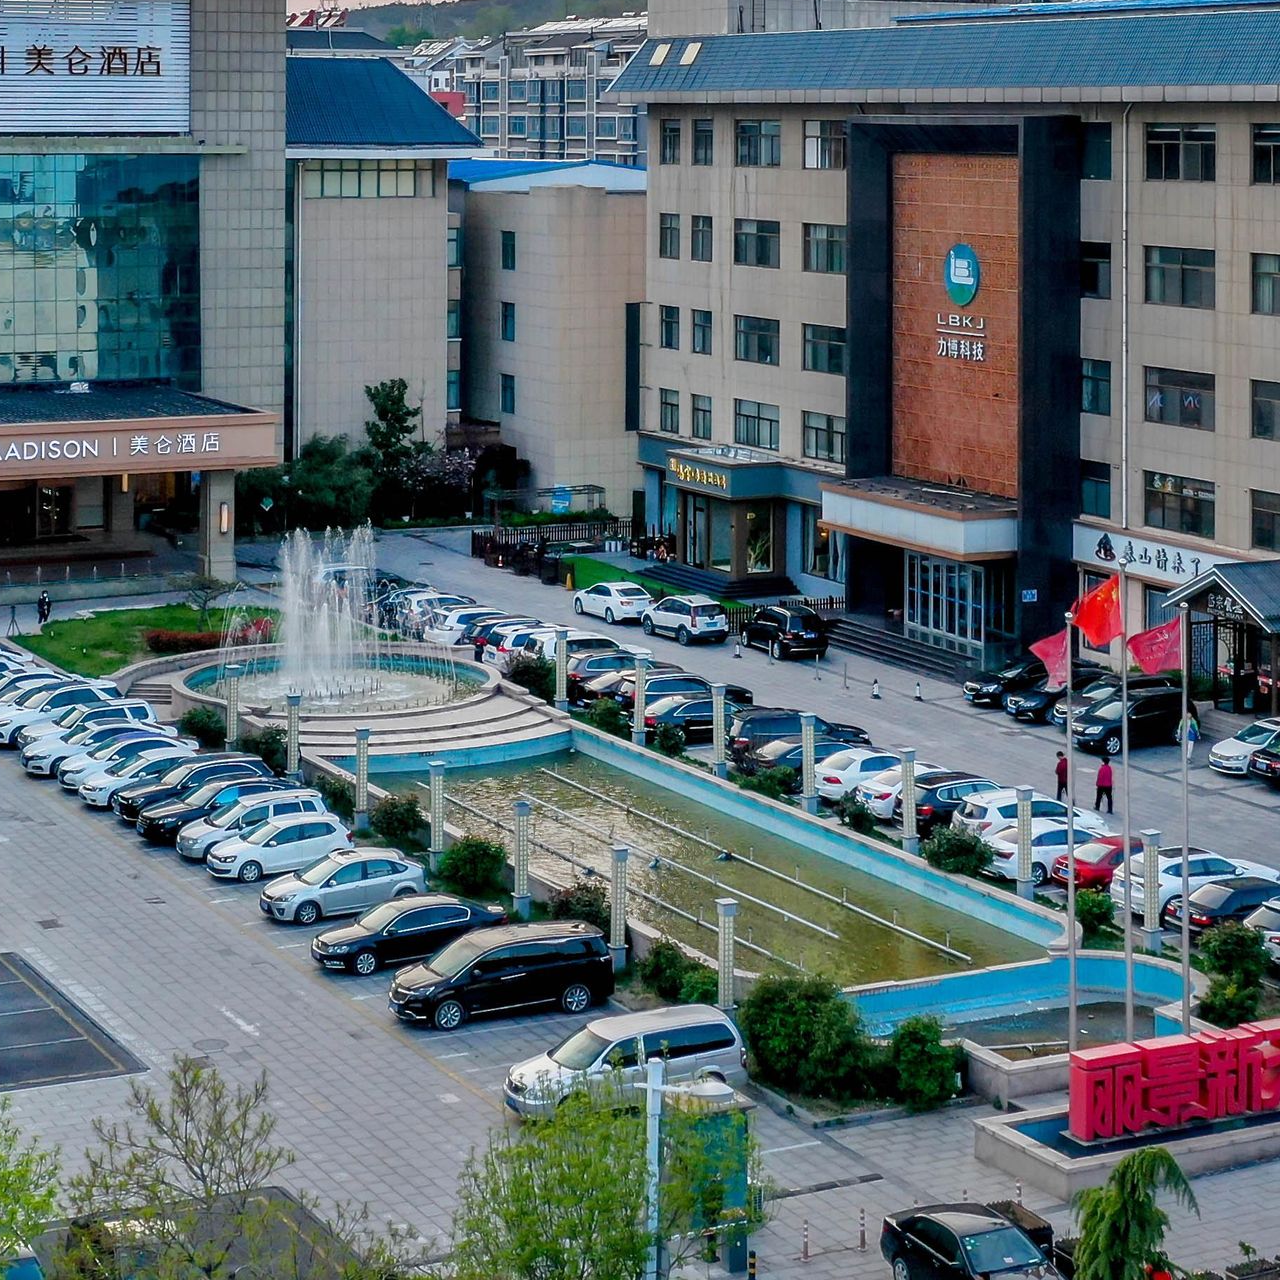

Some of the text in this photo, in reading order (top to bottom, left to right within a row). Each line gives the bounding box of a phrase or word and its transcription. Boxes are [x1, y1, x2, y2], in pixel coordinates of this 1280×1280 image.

[24, 44, 163, 77] 美仑酒店
[937, 312, 984, 329] LBKJ
[937, 336, 984, 361] 力博科技
[129, 431, 221, 456] 美仑酒店
